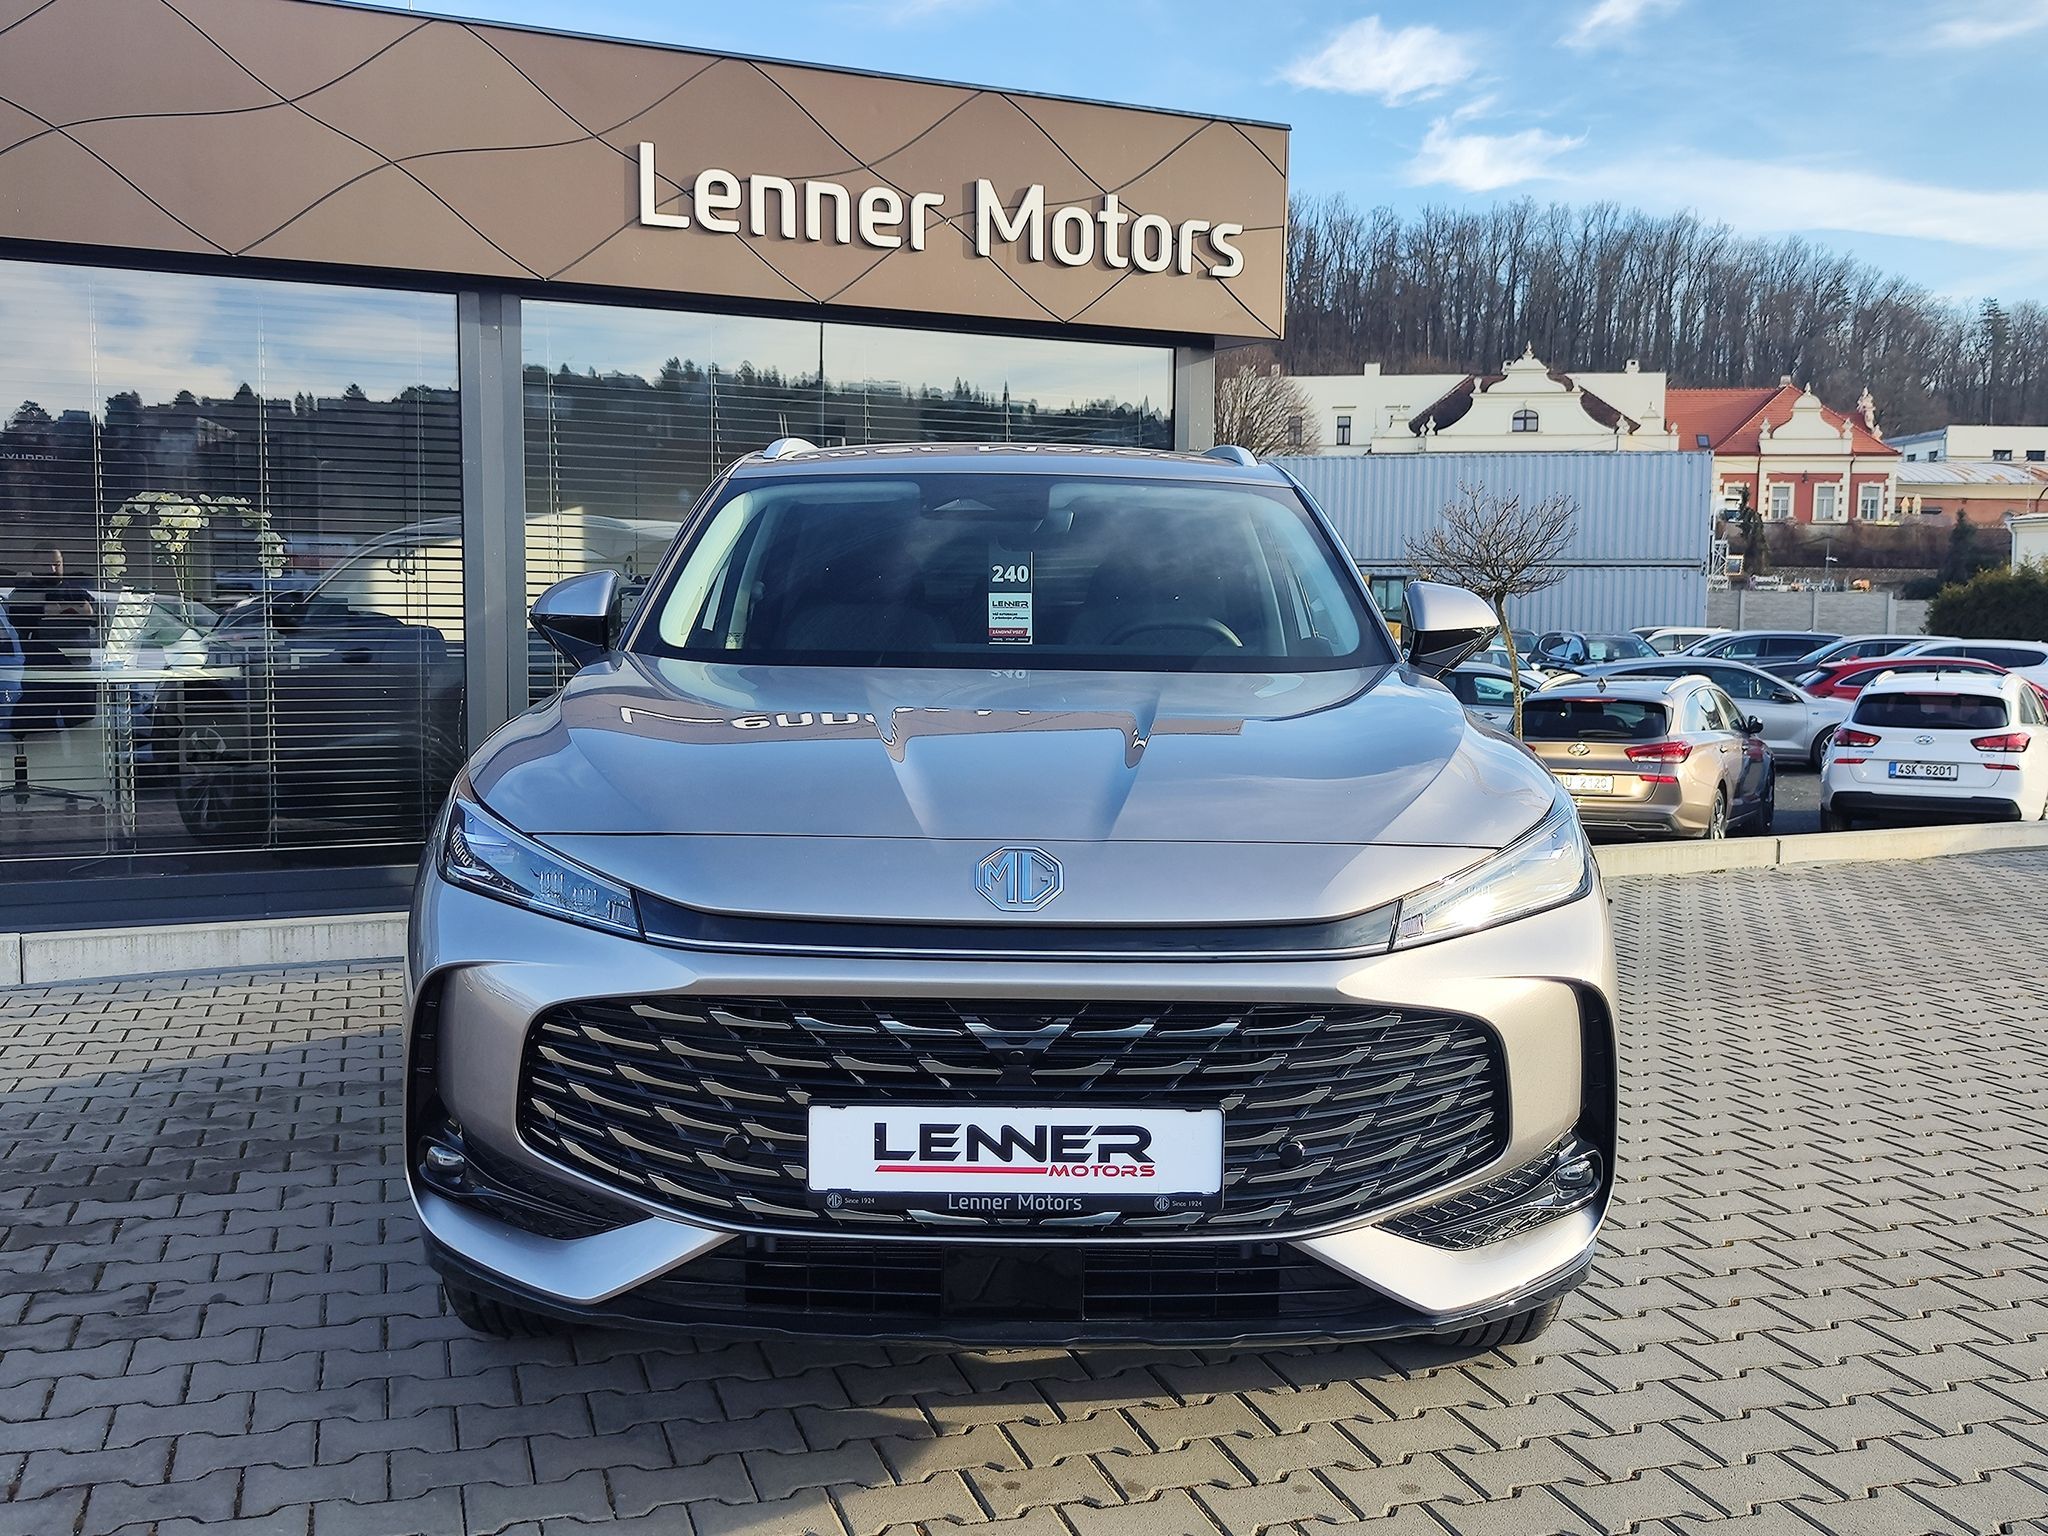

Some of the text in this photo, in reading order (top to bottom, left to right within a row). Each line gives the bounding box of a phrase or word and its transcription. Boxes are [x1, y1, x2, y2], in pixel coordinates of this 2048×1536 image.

[639, 141, 1245, 279] Lenner Motors
[992, 565, 1029, 583] 240
[992, 600, 1028, 608] LENNER
[1898, 764, 1918, 775] 4SK
[1925, 765, 1952, 776] 6201
[982, 849, 1057, 905] MG
[873, 1122, 1156, 1164] LENNER
[1048, 1164, 1156, 1178] MOTORS
[827, 1192, 842, 1208] MG
[844, 1197, 859, 1205] Since
[948, 1193, 1083, 1211] Lenner Motors
[1154, 1195, 1170, 1211] MG
